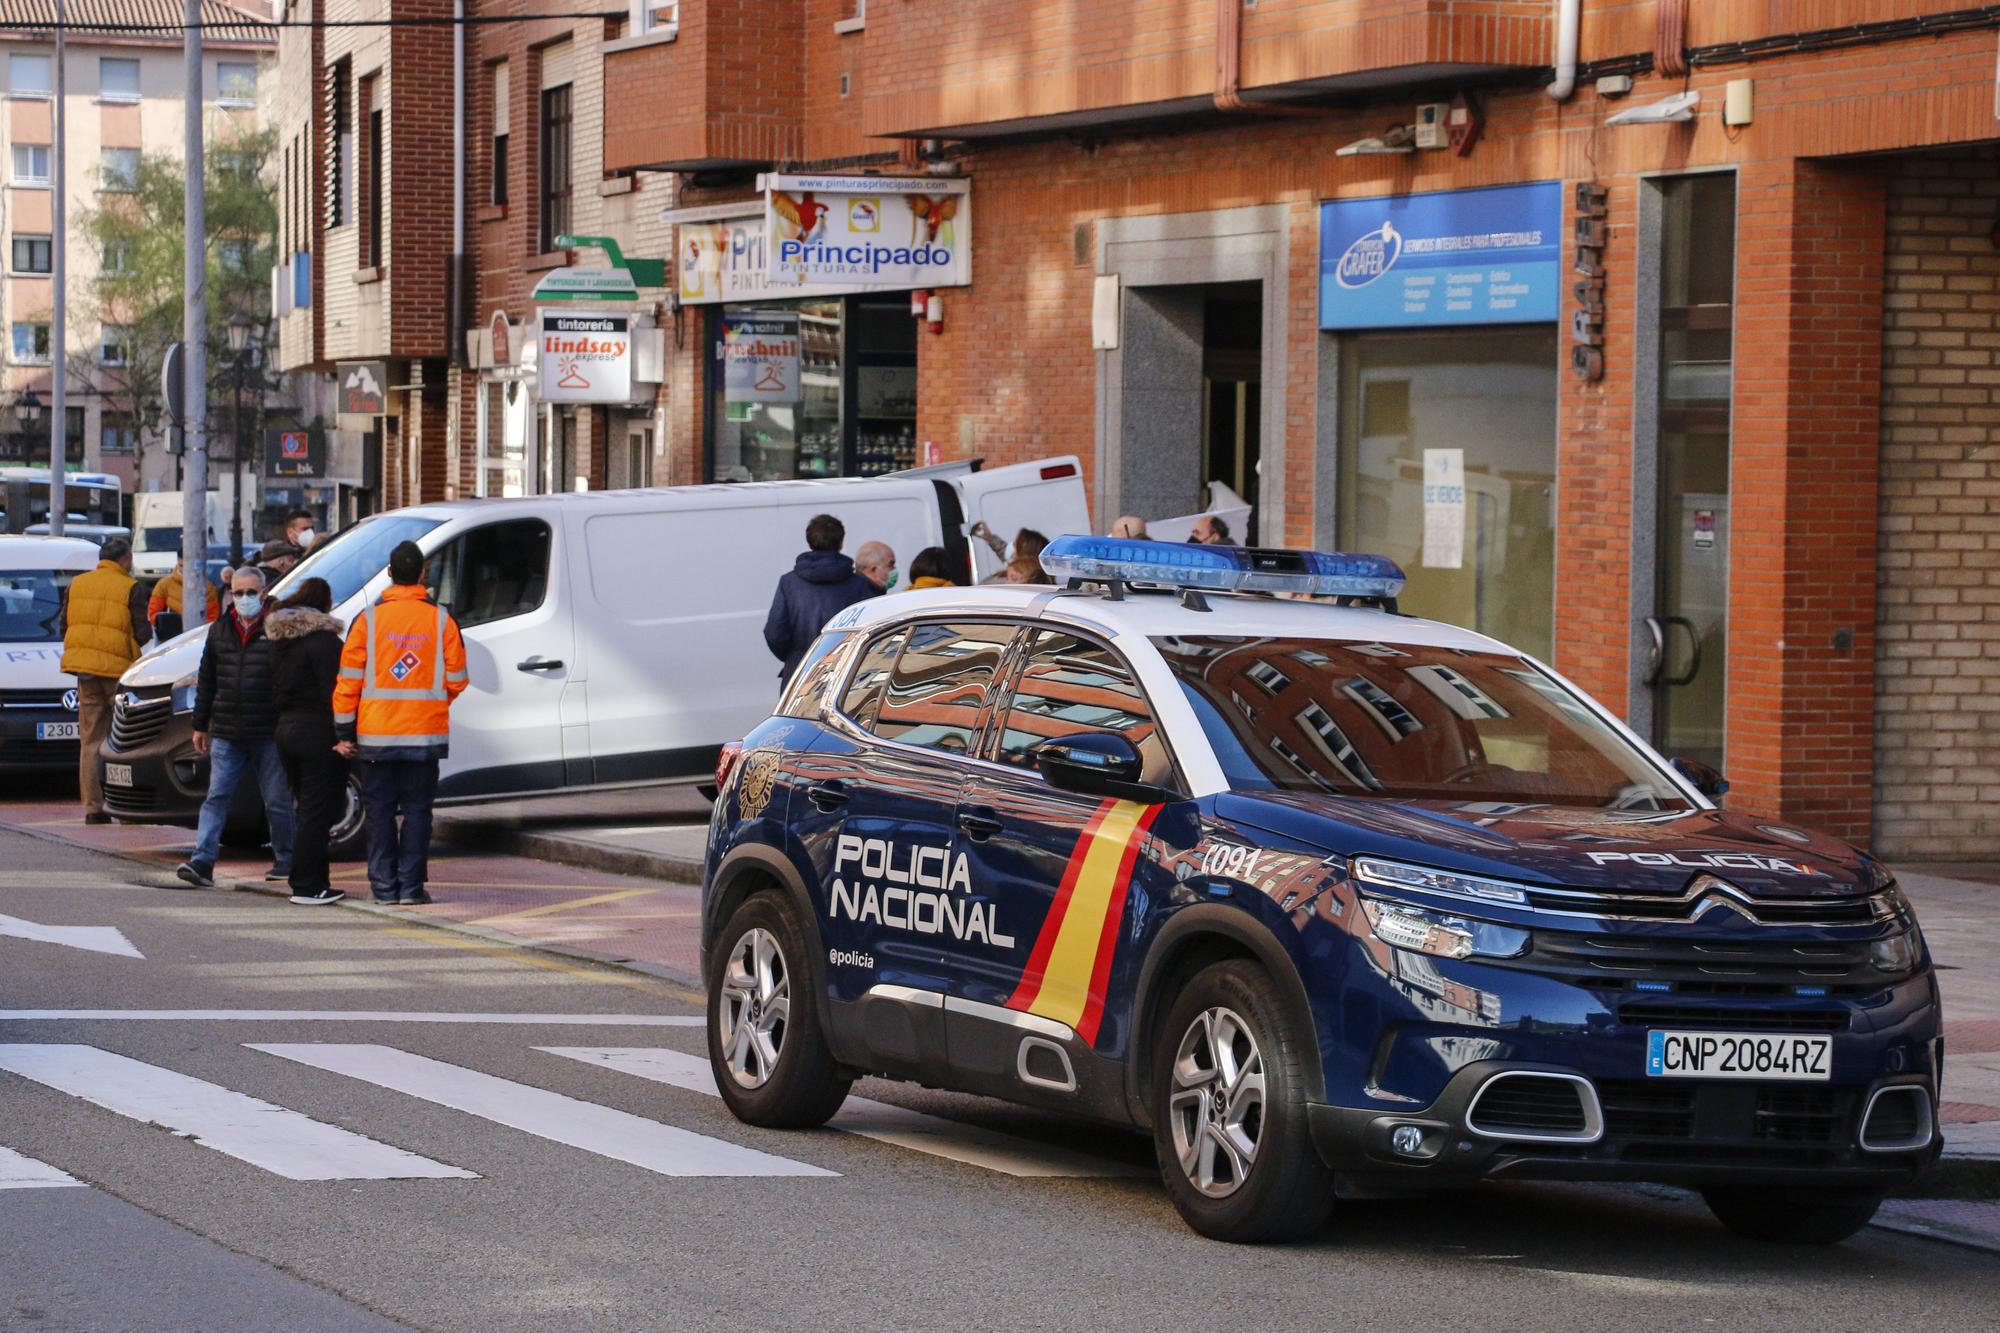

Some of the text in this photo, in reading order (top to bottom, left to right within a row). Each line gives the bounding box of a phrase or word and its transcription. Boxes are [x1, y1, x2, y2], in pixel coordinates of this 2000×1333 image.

[798, 178, 947, 190] www.pinturasprincipado.com
[780, 240, 950, 274] Principado
[1343, 251, 1385, 277] GRAFER
[781, 263, 871, 274] PINTURAS
[557, 319, 614, 331] tintorería
[545, 337, 627, 357] lindsay
[575, 353, 616, 362] express
[834, 834, 972, 893] POLICÍA
[830, 878, 1015, 948] NACIONAL
[829, 948, 875, 969] @policia
[1652, 1057, 1660, 1068] E
